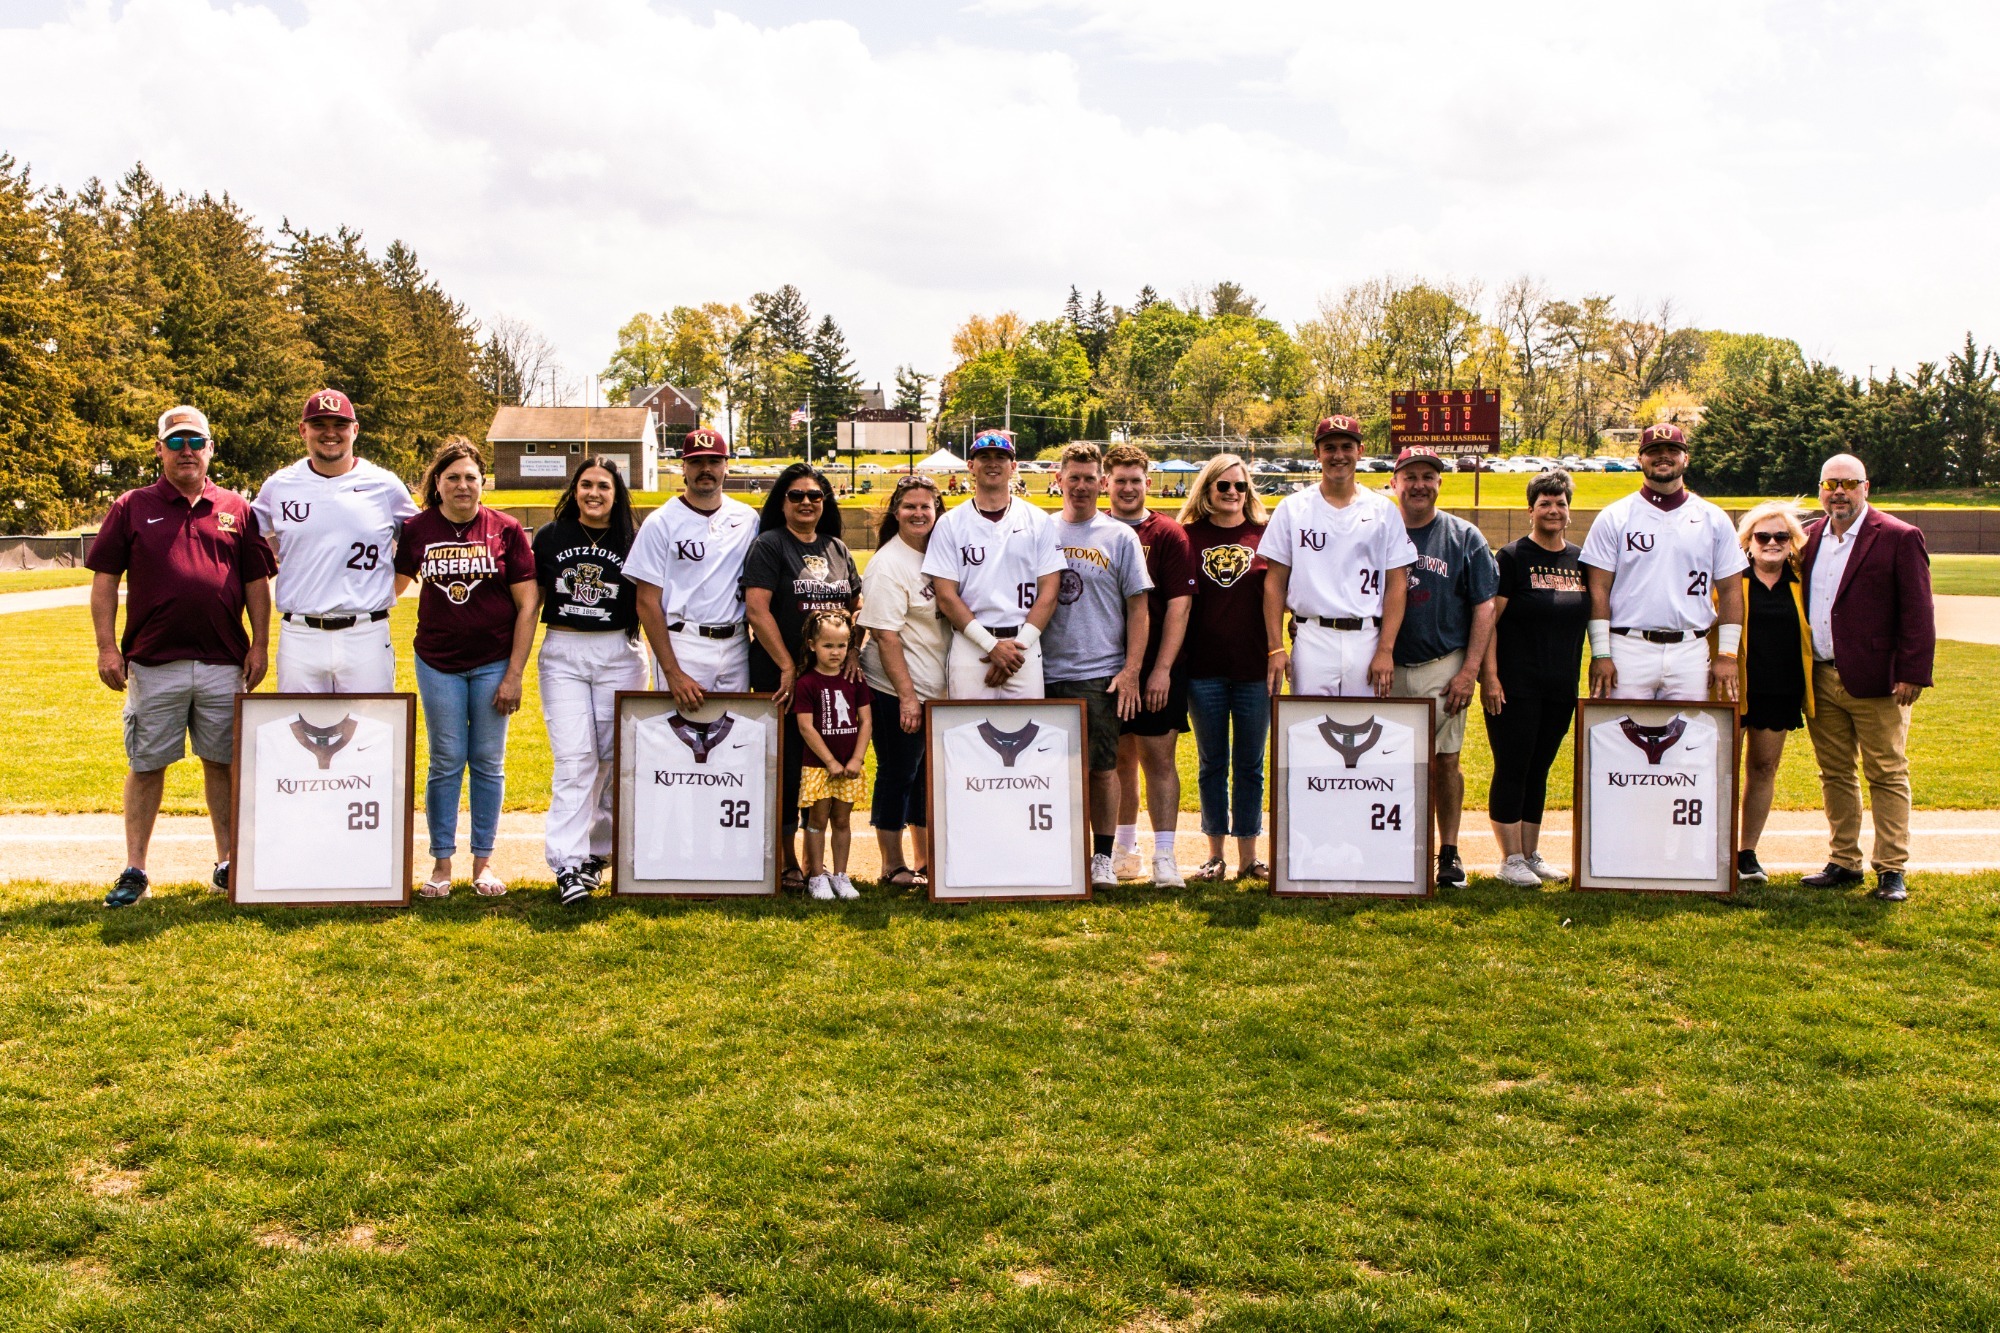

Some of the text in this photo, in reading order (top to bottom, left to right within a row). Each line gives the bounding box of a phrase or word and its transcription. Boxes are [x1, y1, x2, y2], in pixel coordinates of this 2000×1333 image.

[318, 396, 342, 412] KU
[1421, 395, 1427, 404] 0
[1443, 395, 1449, 404] 0
[1465, 394, 1470, 403] 0
[1328, 417, 1350, 430] KU
[1423, 412, 1429, 420] 0
[1445, 411, 1450, 420] 0
[1464, 411, 1470, 420] 0
[1423, 423, 1429, 431] 0
[1444, 422, 1450, 431] 0
[1464, 422, 1470, 431] 0
[1652, 427, 1673, 440] KU
[694, 434, 716, 448] KU
[280, 500, 312, 523] KU
[1299, 528, 1328, 552] KU
[1626, 531, 1655, 553] KU
[346, 542, 379, 571] 29
[428, 546, 486, 560] KUTZTOWN
[675, 539, 706, 562] KU
[960, 543, 985, 566] KU
[421, 557, 499, 579] BASEBALL
[1359, 568, 1380, 595] 24
[573, 583, 602, 606] KU
[1017, 582, 1036, 609] 15
[568, 606, 580, 614] EST
[276, 775, 374, 794] KUTZTOWN
[654, 770, 746, 788] KUTZTOWN
[965, 775, 1052, 792] KUTZTOWN
[1307, 777, 1395, 792] KUTZTOWN
[1608, 772, 1698, 788] KUTZTOWN
[348, 801, 380, 830] 29
[720, 799, 750, 828] 32
[1029, 803, 1053, 831] 15
[1371, 803, 1401, 831] 24
[1673, 798, 1702, 826] 28
